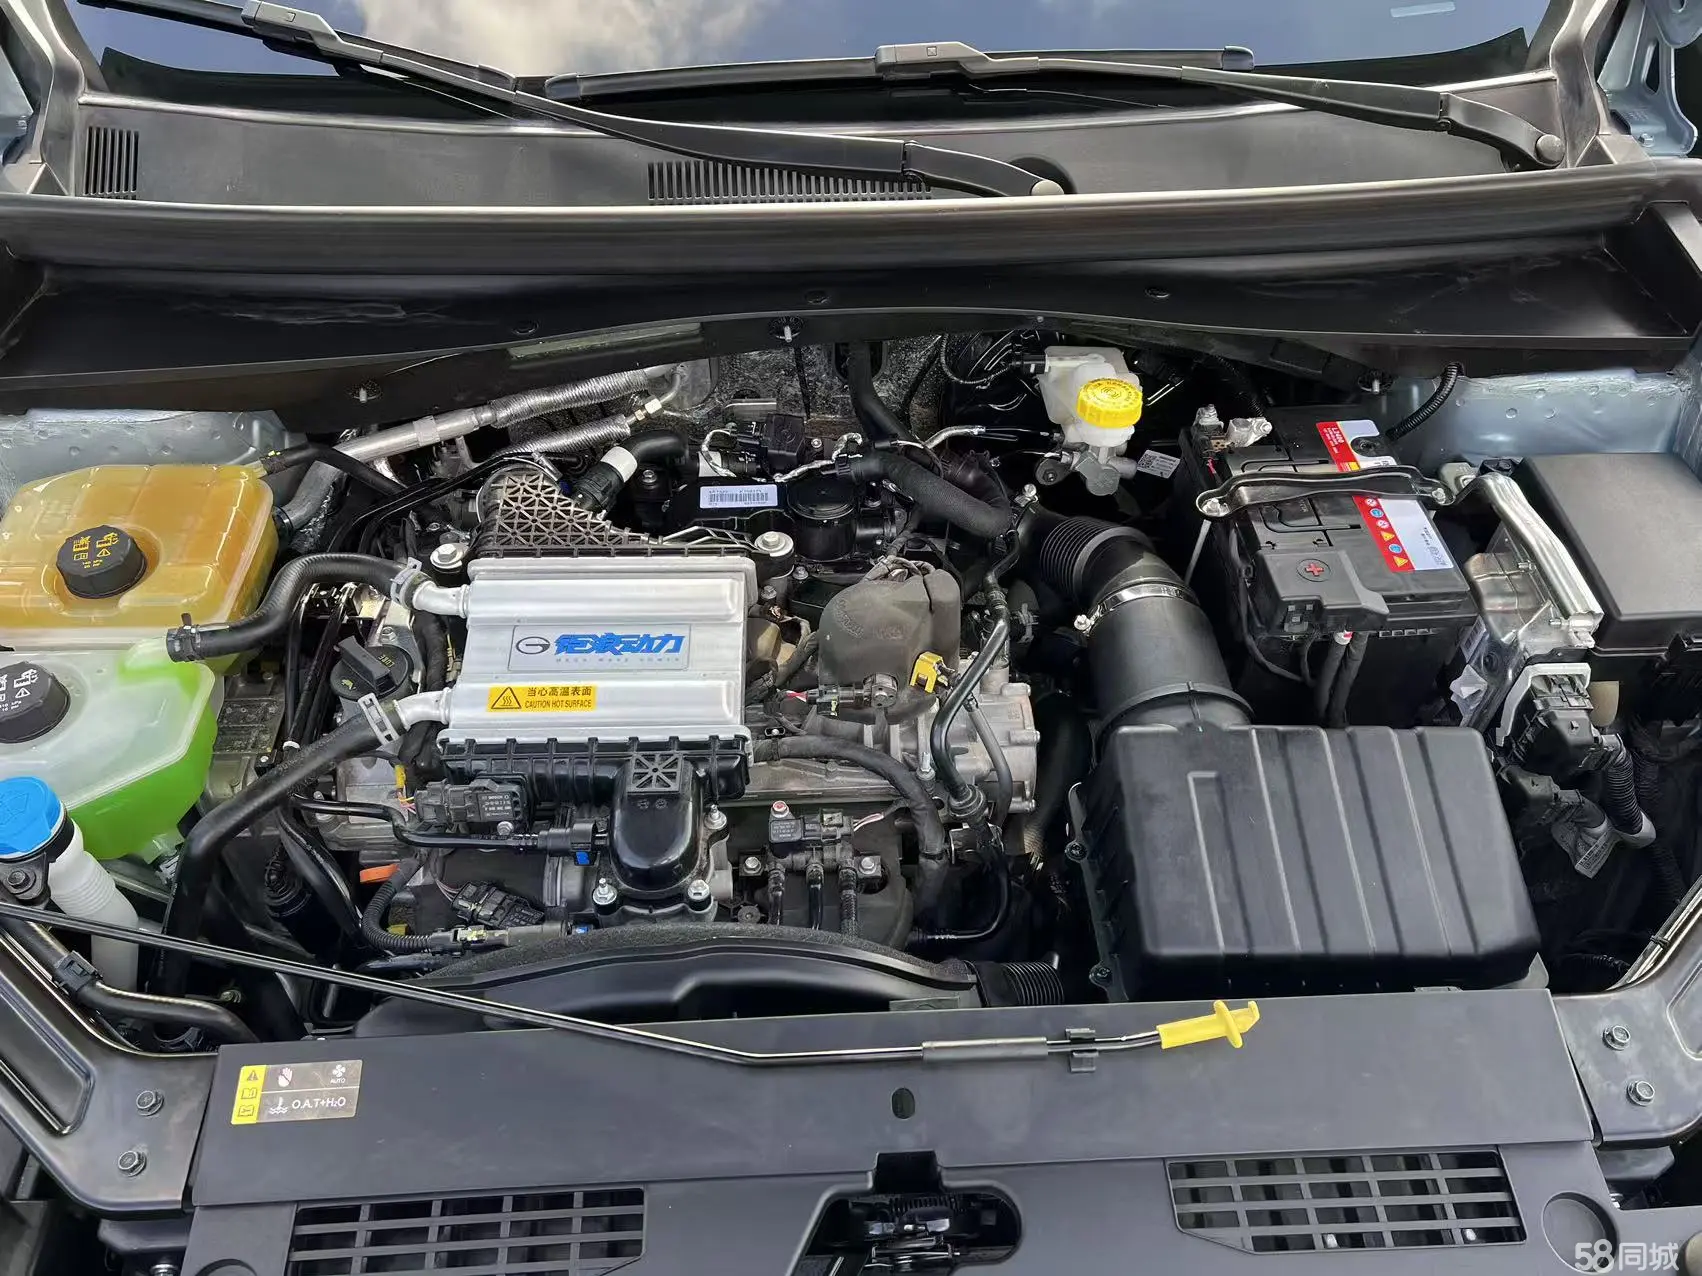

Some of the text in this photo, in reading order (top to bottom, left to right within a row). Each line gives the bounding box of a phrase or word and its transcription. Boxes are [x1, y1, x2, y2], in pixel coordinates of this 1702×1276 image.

[527, 686, 593, 697] 当心高温表面
[524, 699, 592, 709] CAUTION HOT SURFACE
[330, 1077, 346, 1085] AUTO
